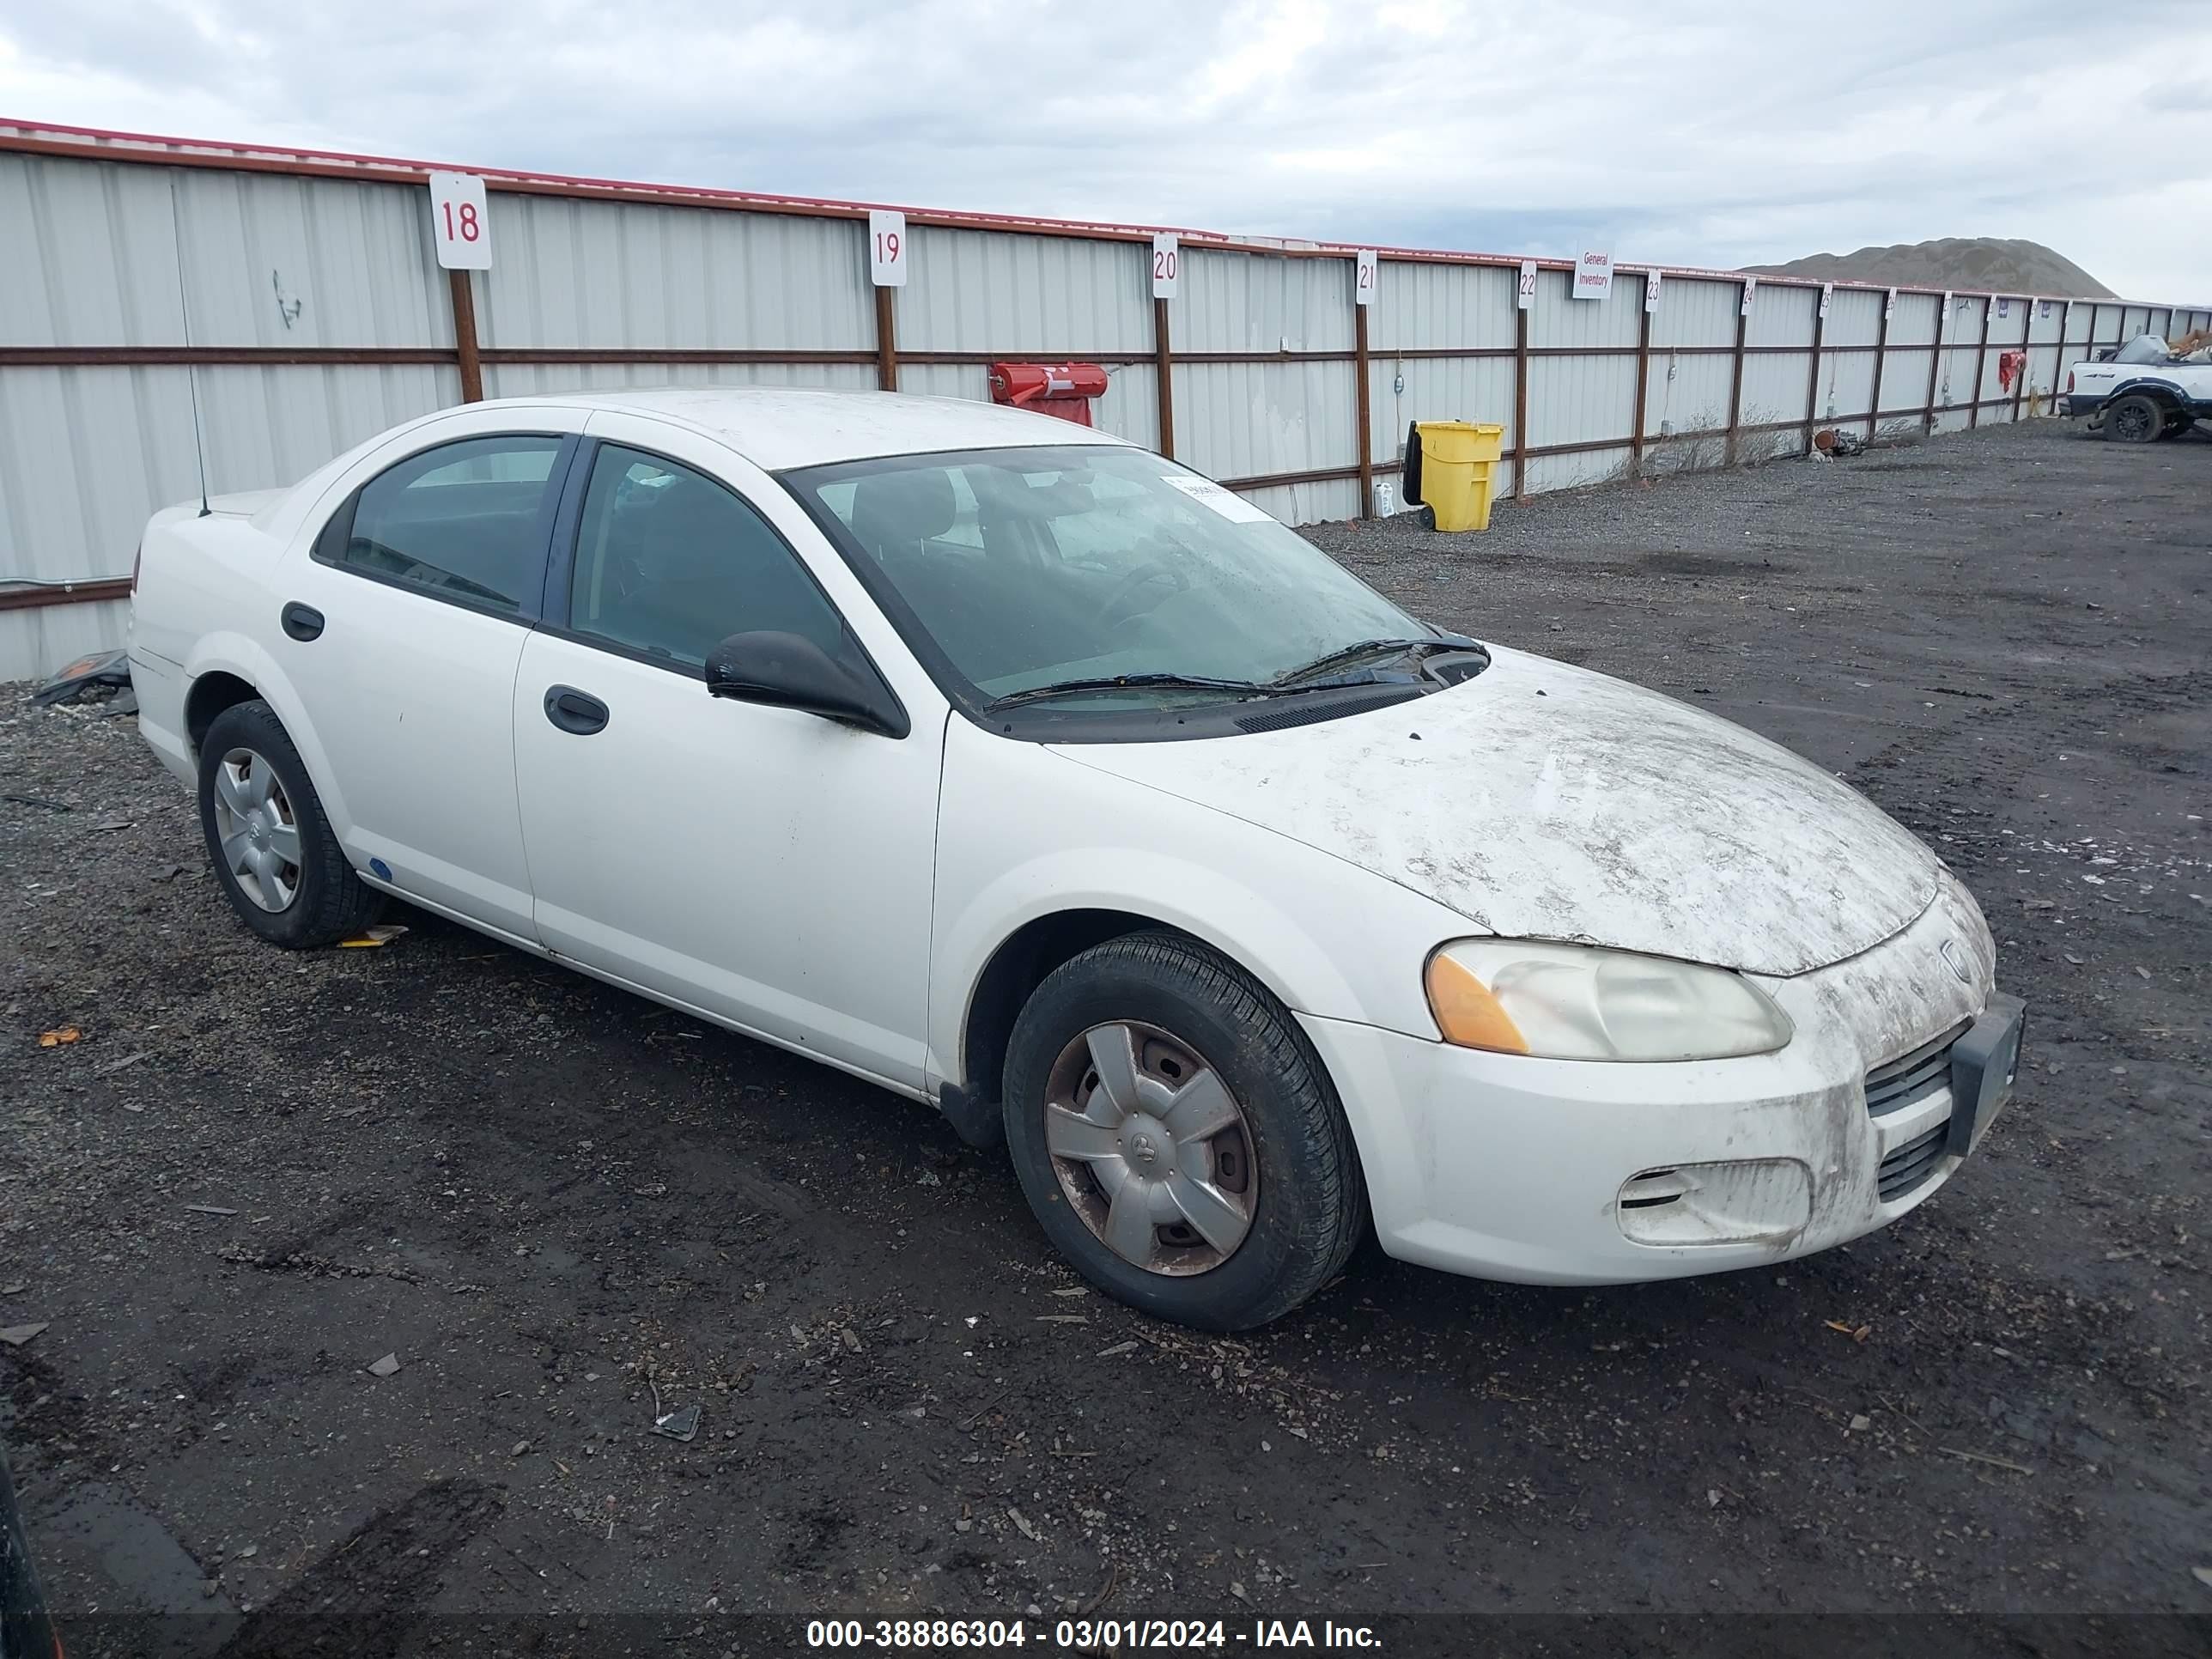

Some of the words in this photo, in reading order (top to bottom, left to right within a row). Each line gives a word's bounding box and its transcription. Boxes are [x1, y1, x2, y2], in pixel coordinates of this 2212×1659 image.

[443, 202, 478, 241] 18
[877, 233, 899, 264] 19
[1155, 251, 1176, 280] 20
[1584, 252, 1608, 266] General
[1360, 264, 1374, 289] 21
[1521, 274, 1535, 295] 22
[1579, 272, 1608, 289] Inventory
[1648, 281, 1659, 300] 23
[1744, 287, 1753, 304] 24
[1821, 293, 1831, 308] 25
